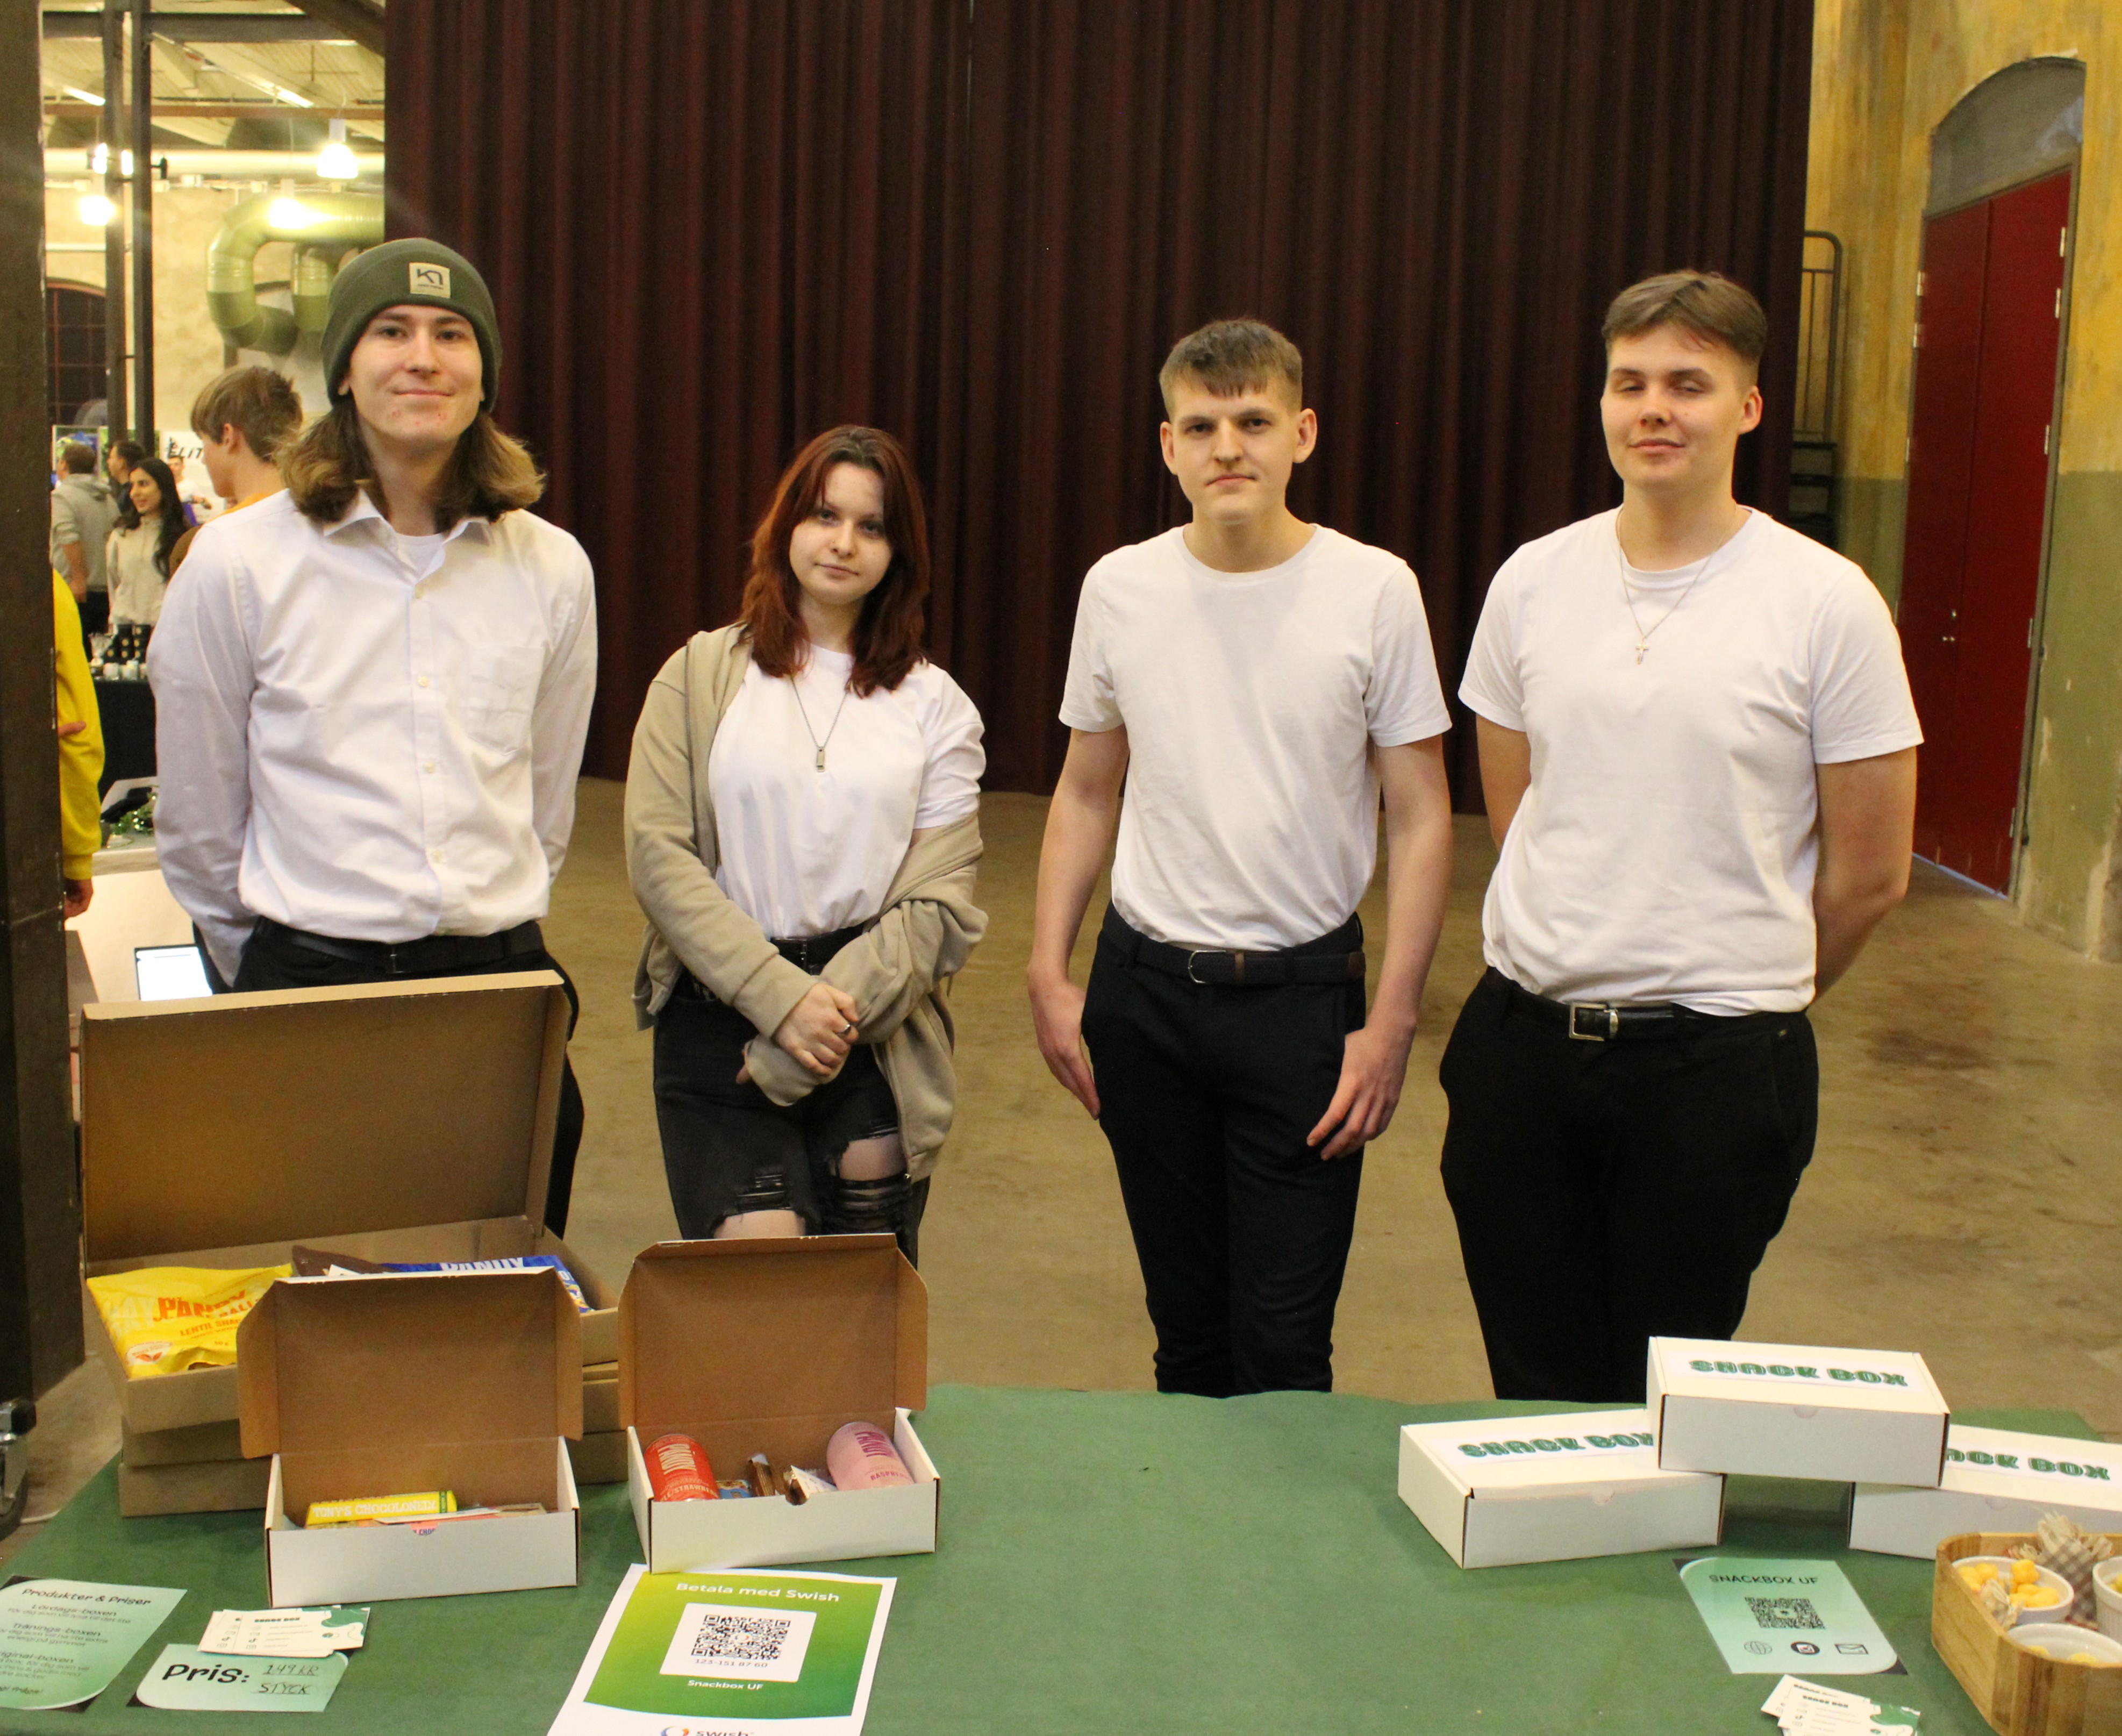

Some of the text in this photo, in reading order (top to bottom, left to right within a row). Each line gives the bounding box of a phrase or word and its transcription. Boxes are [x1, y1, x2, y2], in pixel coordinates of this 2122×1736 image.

[1689, 1360, 1908, 1387] SNACK BOX
[1457, 1438, 1586, 1457] SNACK
[1947, 1448, 2111, 1480] ACK BOX
[313, 1506, 352, 1518] TONY'S
[355, 1500, 437, 1515] CHOCOLONELY
[1709, 1575, 1795, 1584] SNACKBOX
[22, 1588, 93, 1601] Produkter
[109, 1596, 151, 1606] Priser
[676, 1583, 840, 1602] Betala med Swish
[695, 1659, 735, 1667] 123-151
[162, 1664, 249, 1683] Pris:
[259, 1682, 311, 1694] STYCK
[688, 1680, 744, 1689] Snackbox
